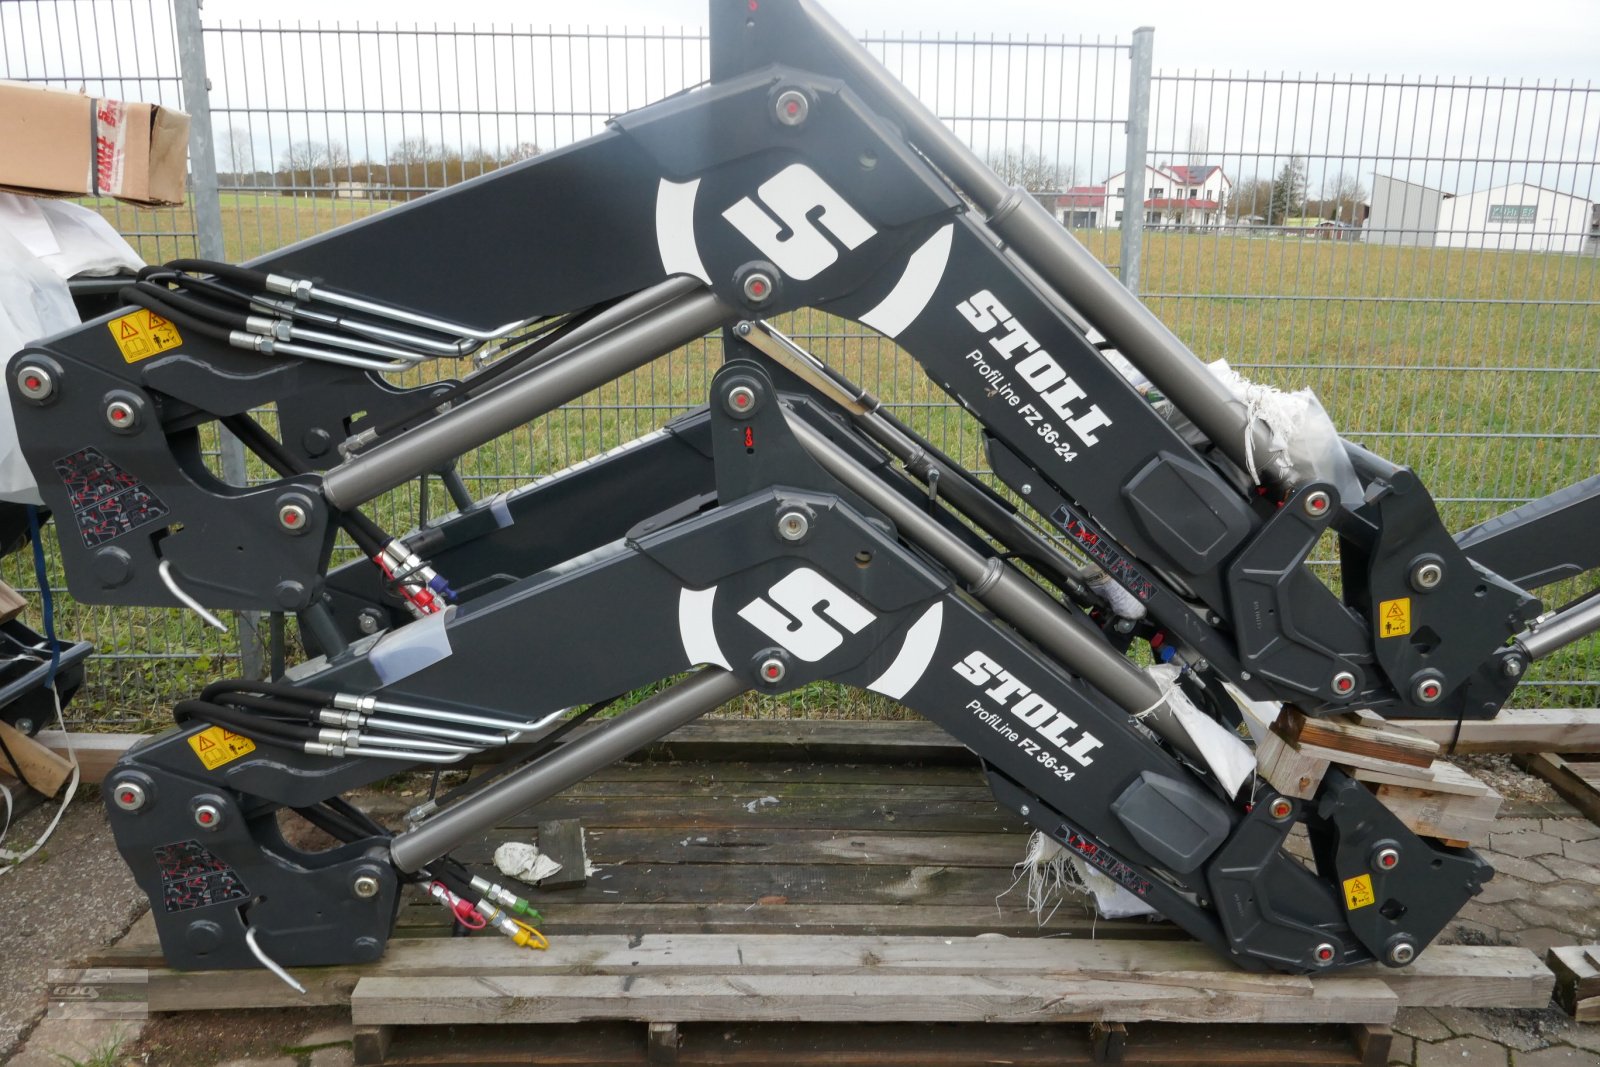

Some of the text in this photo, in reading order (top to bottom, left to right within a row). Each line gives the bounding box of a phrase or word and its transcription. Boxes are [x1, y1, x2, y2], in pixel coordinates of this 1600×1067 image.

[721, 163, 878, 281] S
[955, 289, 1113, 448] STOLL
[965, 349, 1078, 463] ProfiLine FZ 36-24
[737, 567, 878, 662] S
[952, 650, 1104, 767] STOLL
[965, 699, 1076, 782] ProfiLine FZ 36-24
